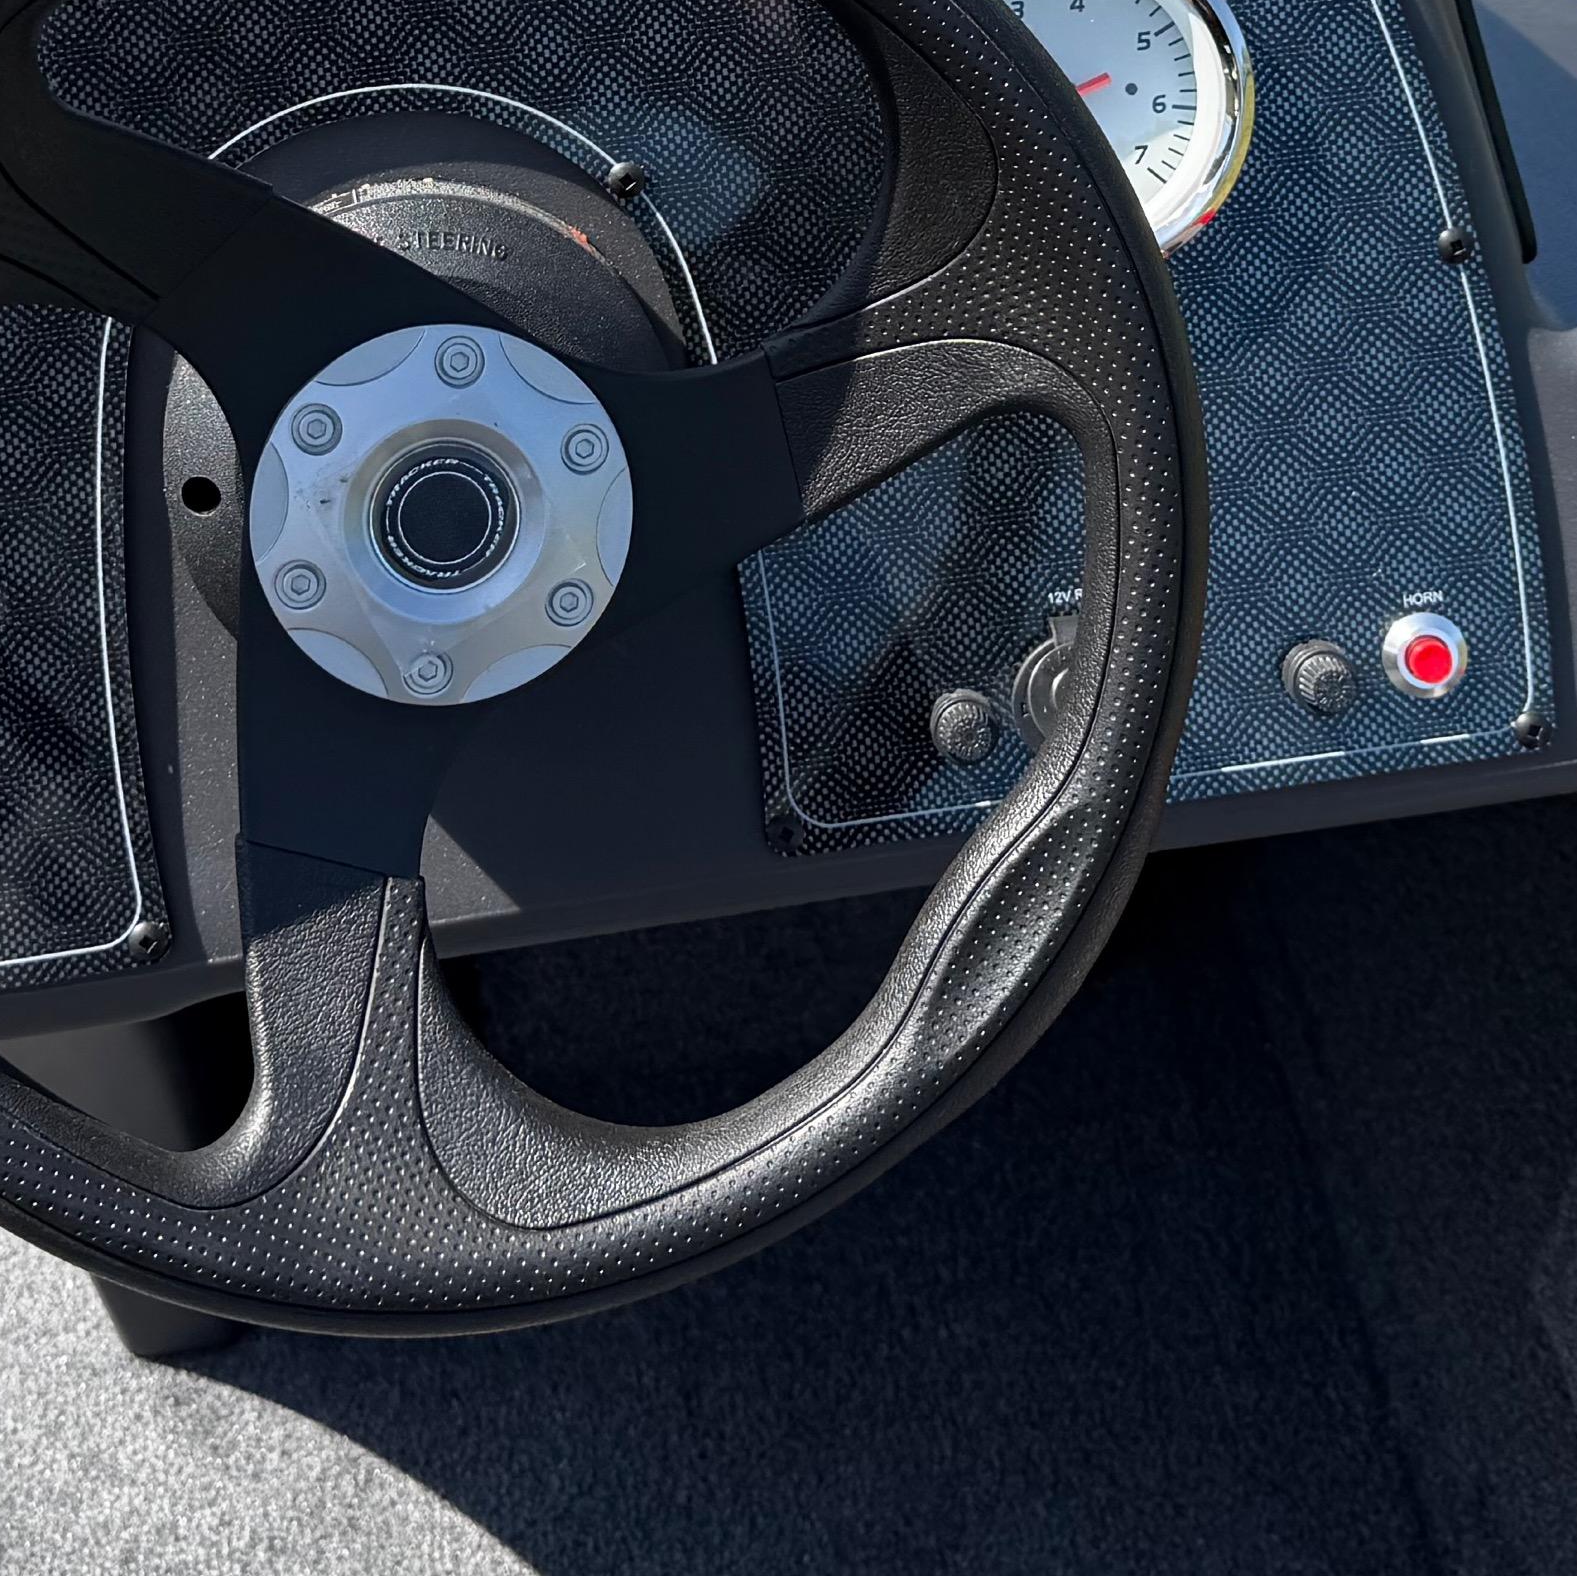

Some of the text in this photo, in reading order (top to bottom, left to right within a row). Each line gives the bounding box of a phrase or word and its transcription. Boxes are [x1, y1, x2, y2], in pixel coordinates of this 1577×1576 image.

[1011, 1, 1024, 19] 3
[1137, 31, 1151, 51] 5
[1152, 94, 1166, 114] 6
[1135, 145, 1149, 165] 7
[397, 229, 508, 261] STEERING
[386, 458, 460, 506] TRACKER
[483, 473, 505, 558] TRACKER
[387, 534, 461, 578] TRACKER
[1048, 589, 1072, 604] 12V
[1403, 590, 1444, 608] HORN
